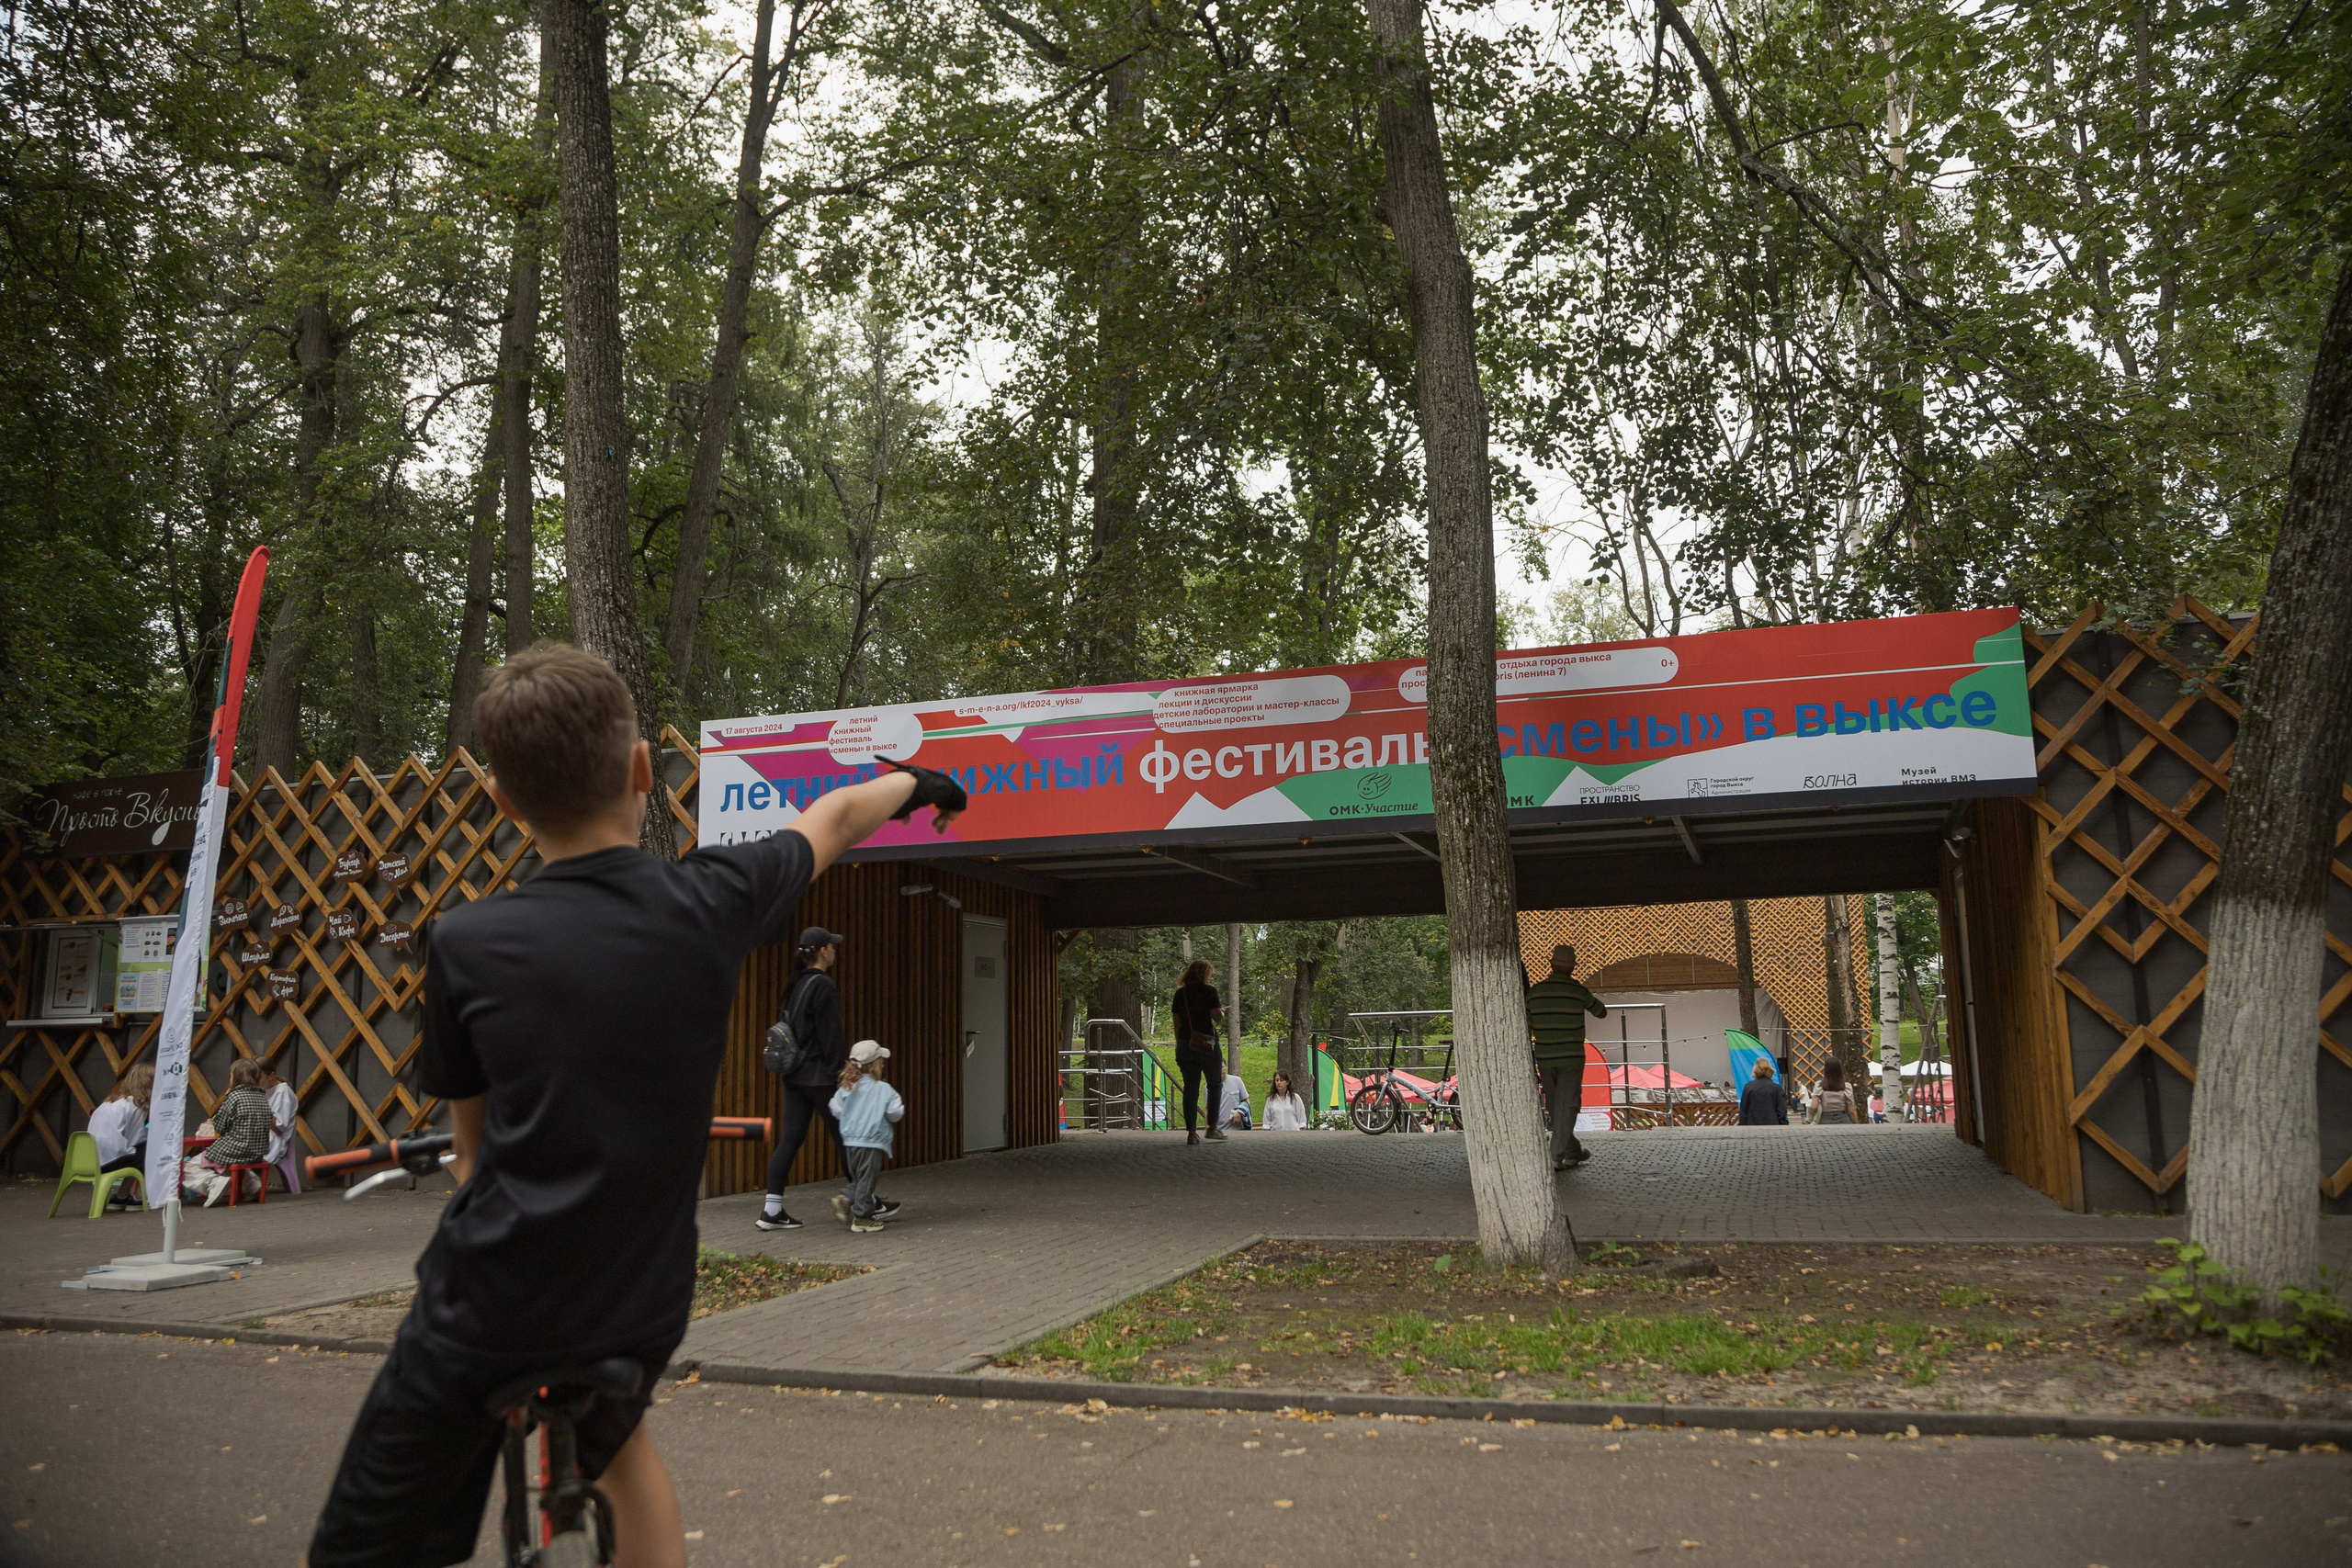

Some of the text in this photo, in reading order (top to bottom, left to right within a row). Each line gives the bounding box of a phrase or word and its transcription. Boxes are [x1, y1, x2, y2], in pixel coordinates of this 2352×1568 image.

[1499, 653, 1611, 670] отдыха города выкса
[1661, 658, 1675, 668] 0+
[1514, 669, 1555, 680] (ленина
[1557, 667, 1566, 676] 7)
[1174, 683, 1259, 697] книжная ярмарка
[1158, 699, 1193, 709] лекции
[1201, 694, 1252, 706] дискуссии
[1153, 710, 1191, 720] детские
[1192, 705, 1254, 716] лаборатории
[1264, 697, 1340, 710] мастер-классы
[849, 715, 878, 725] летний
[1159, 714, 1265, 729] специальные проекты
[733, 726, 763, 736] августа
[763, 723, 783, 732] 2024
[834, 726, 872, 735] книжный
[829, 736, 872, 746] фестиваль
[872, 742, 898, 751] выксе
[937, 742, 1125, 795] ижный
[1496, 713, 1724, 758] смены»
[1742, 707, 1777, 741] в
[1794, 690, 1997, 739] выксе
[1901, 766, 1937, 777] Музей
[1579, 784, 1641, 795] ПРОСТРАНСТВО
[1506, 795, 1535, 807] МК
[36, 798, 120, 847] Просто
[337, 857, 361, 871] Бургер
[379, 856, 406, 871] Детский
[218, 912, 249, 927] Выпечка
[270, 914, 300, 929] Мороженое
[328, 915, 343, 926] Чай
[338, 926, 356, 938] Кофе
[379, 930, 411, 943] Десерты
[241, 952, 271, 964] Шаурма
[269, 973, 297, 984] Картофель
[280, 986, 295, 998] фри
